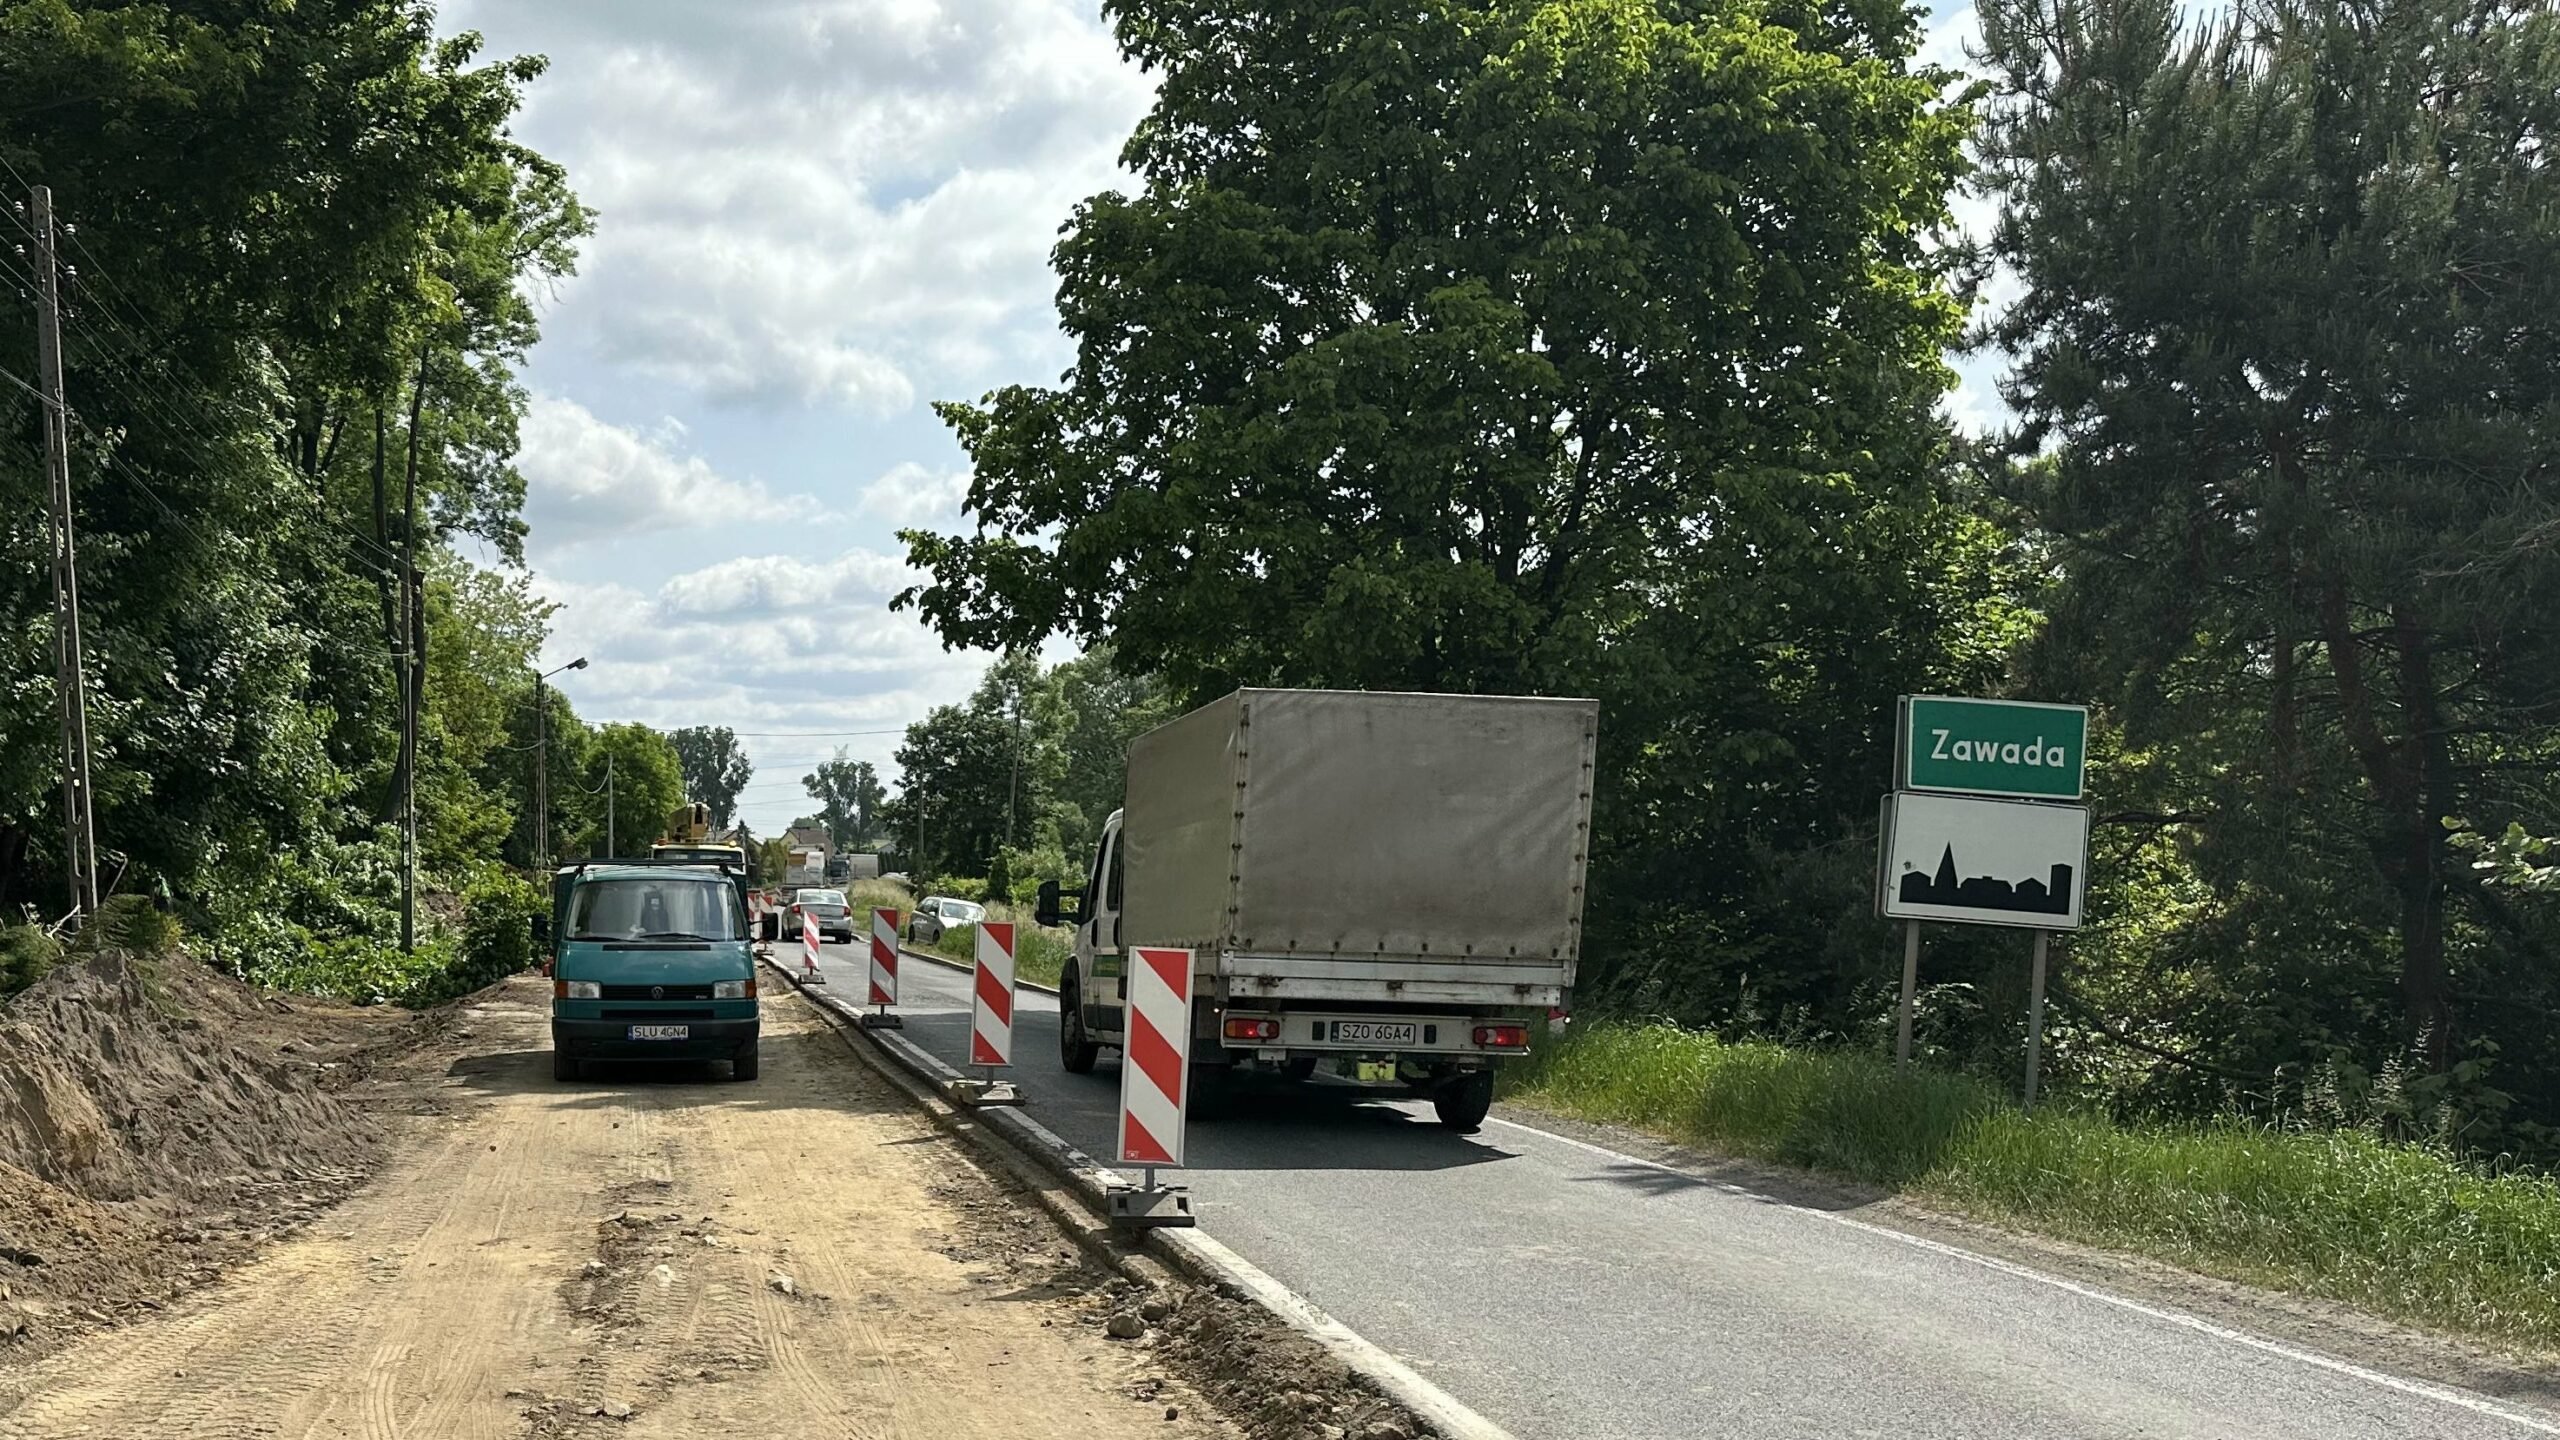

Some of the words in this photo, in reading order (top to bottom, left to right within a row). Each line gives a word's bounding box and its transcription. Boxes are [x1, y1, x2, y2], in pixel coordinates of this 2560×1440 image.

[1930, 729, 2065, 768] Zawada
[634, 1027, 657, 1037] SLU
[660, 1027, 686, 1037] 4GN4
[1342, 1024, 1370, 1039] SZO
[1375, 1025, 1411, 1040] 6GA4
